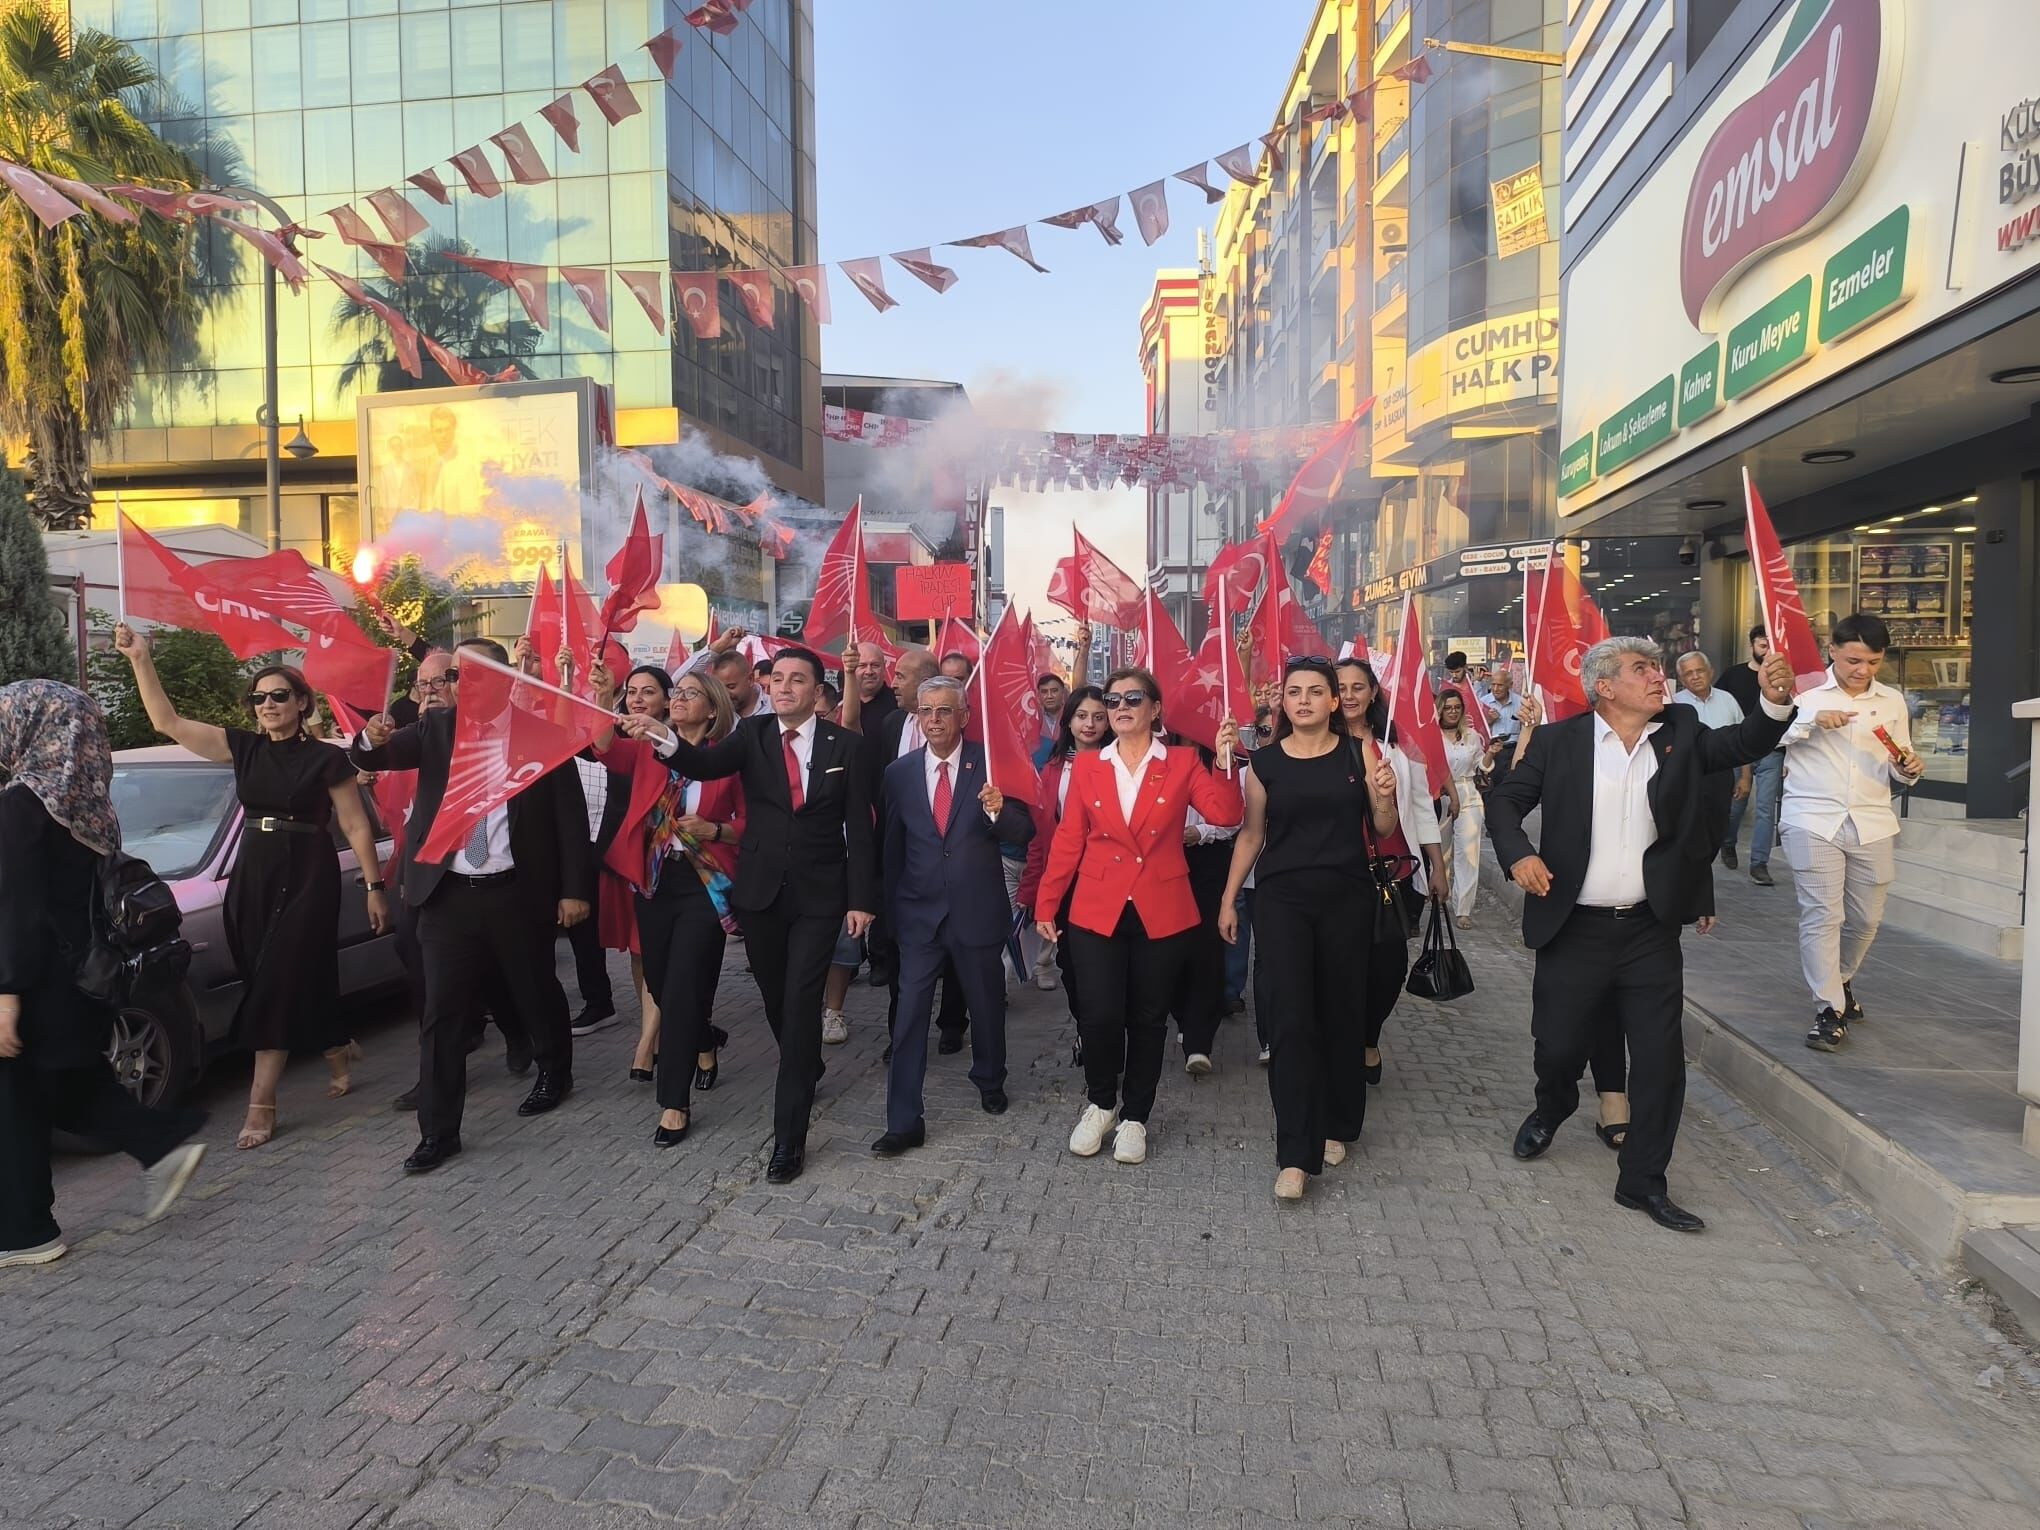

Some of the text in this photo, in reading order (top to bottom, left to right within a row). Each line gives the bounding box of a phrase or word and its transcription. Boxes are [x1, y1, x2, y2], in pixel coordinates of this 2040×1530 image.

[1702, 24, 1842, 257] emsal
[1513, 172, 1538, 190] ADA
[1498, 193, 1543, 230] SATILIK
[1828, 246, 1894, 312] Ezmeler
[1455, 319, 1559, 361] CUMHU
[1731, 310, 1801, 373] Kuru Meyve
[1452, 359, 1522, 397] HALK
[1683, 371, 1712, 404] Kahve
[502, 415, 559, 446] TEK
[1600, 431, 1622, 457] Lokum
[1628, 400, 1667, 444] Şekerleme
[1561, 449, 1589, 481] Kuruyemiş
[512, 546, 552, 566] 999
[708, 602, 749, 627] ekerbank
[932, 594, 957, 612] CHP
